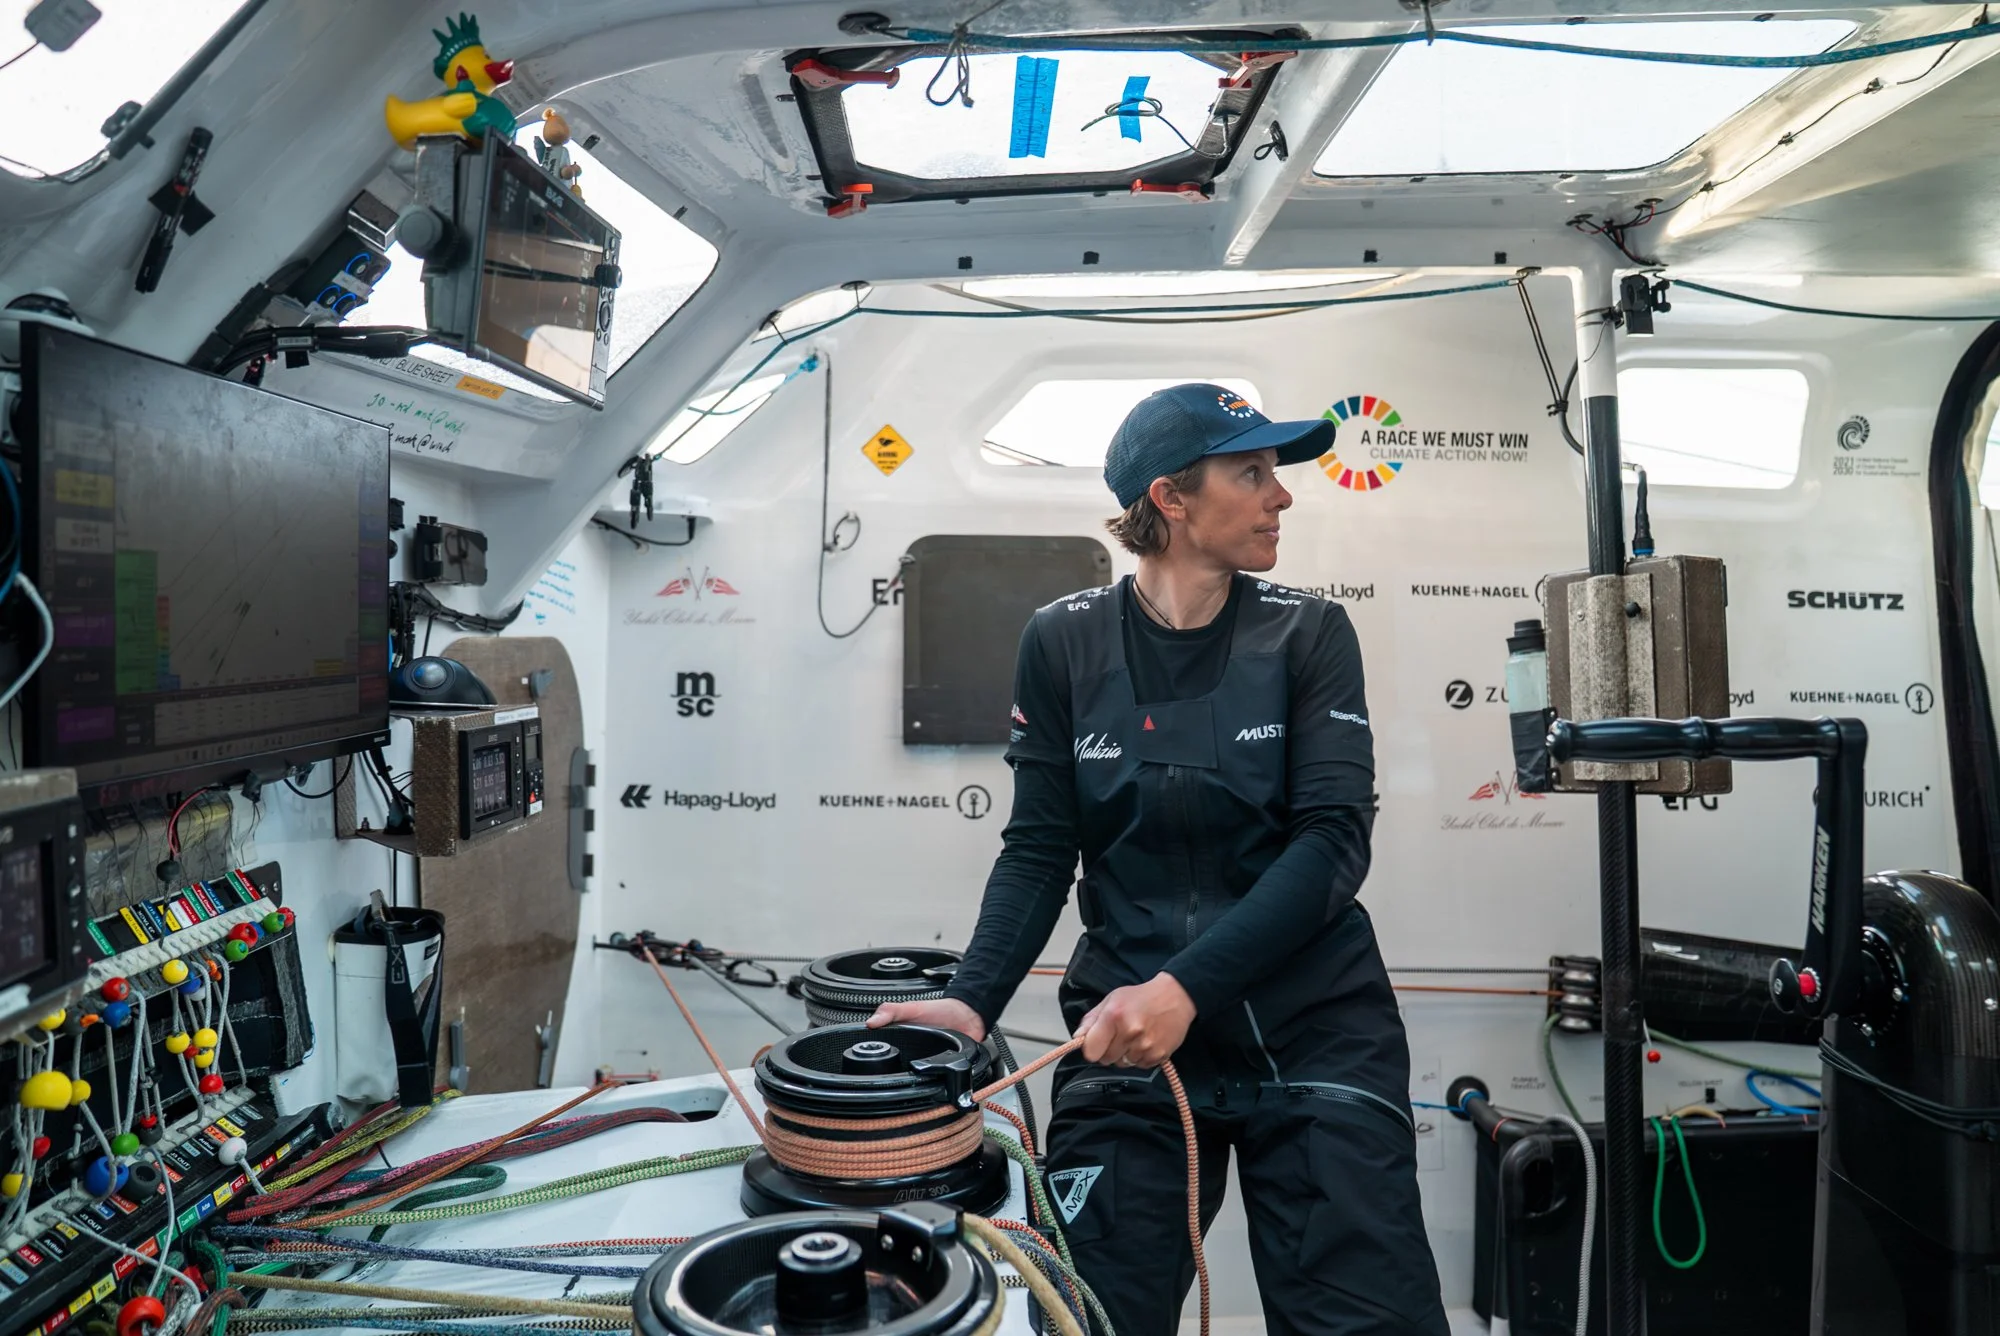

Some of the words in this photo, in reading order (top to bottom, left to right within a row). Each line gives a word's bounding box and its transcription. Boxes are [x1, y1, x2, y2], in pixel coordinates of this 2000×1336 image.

[1361, 430, 1371, 445] A
[1376, 430, 1417, 446] RACE
[1422, 431, 1446, 447] WE
[1451, 432, 1494, 448] MUST
[1499, 433, 1529, 449] WIN
[1370, 447, 1430, 460] CLIMATE
[1434, 449, 1487, 461] ACTION
[1491, 450, 1528, 462] NOW!
[1411, 584, 1530, 598] KUEHNE+NAGEL
[1067, 601, 1090, 612] EFG
[1787, 590, 1904, 611] SCHÜTZ
[1790, 691, 1900, 705] KUEHNE+NAGEL
[1074, 732, 1123, 763] Malizia
[664, 790, 776, 811] Hapag-Lloyd
[819, 794, 951, 809] KUEHNE+NAGEL
[1864, 791, 1924, 807] URICH
[1811, 825, 1830, 935] HARKEN
[198, 1136, 214, 1150] Arthur
[1053, 1171, 1079, 1181] MUSTO
[928, 1184, 950, 1197] 300
[1065, 1171, 1095, 1213] MPX
[43, 1237, 63, 1255] Arthur
